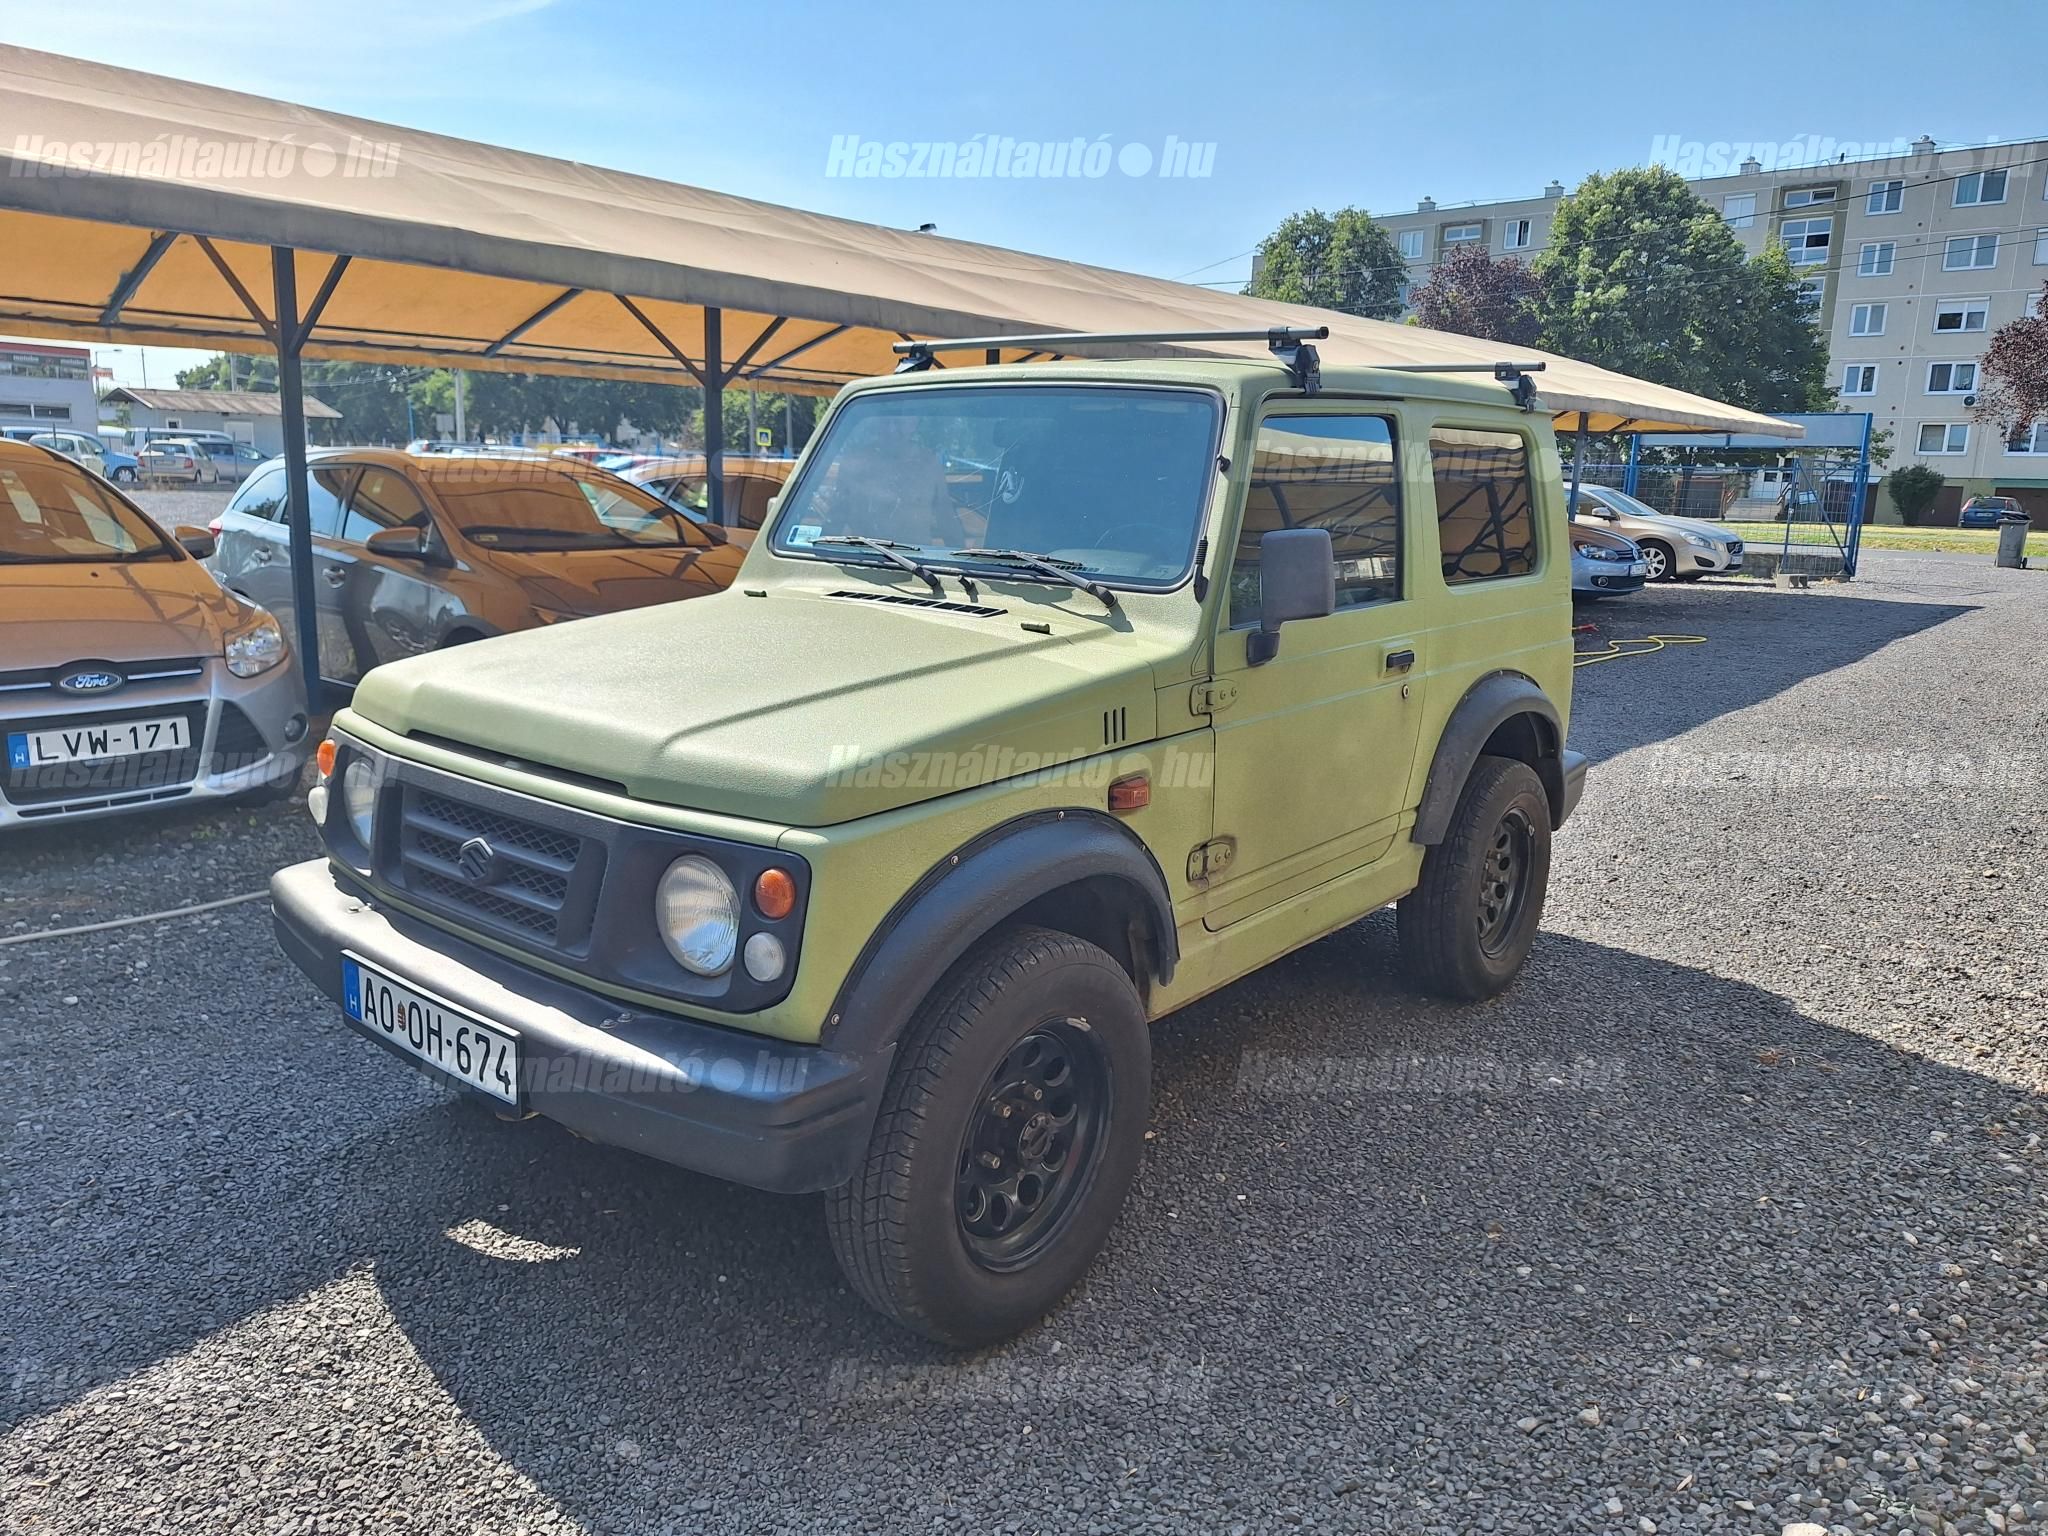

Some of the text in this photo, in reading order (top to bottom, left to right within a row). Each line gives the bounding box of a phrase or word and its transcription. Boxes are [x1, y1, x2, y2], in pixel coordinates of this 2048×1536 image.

[75, 673, 109, 688] Ford
[15, 722, 179, 763] H LVW-171
